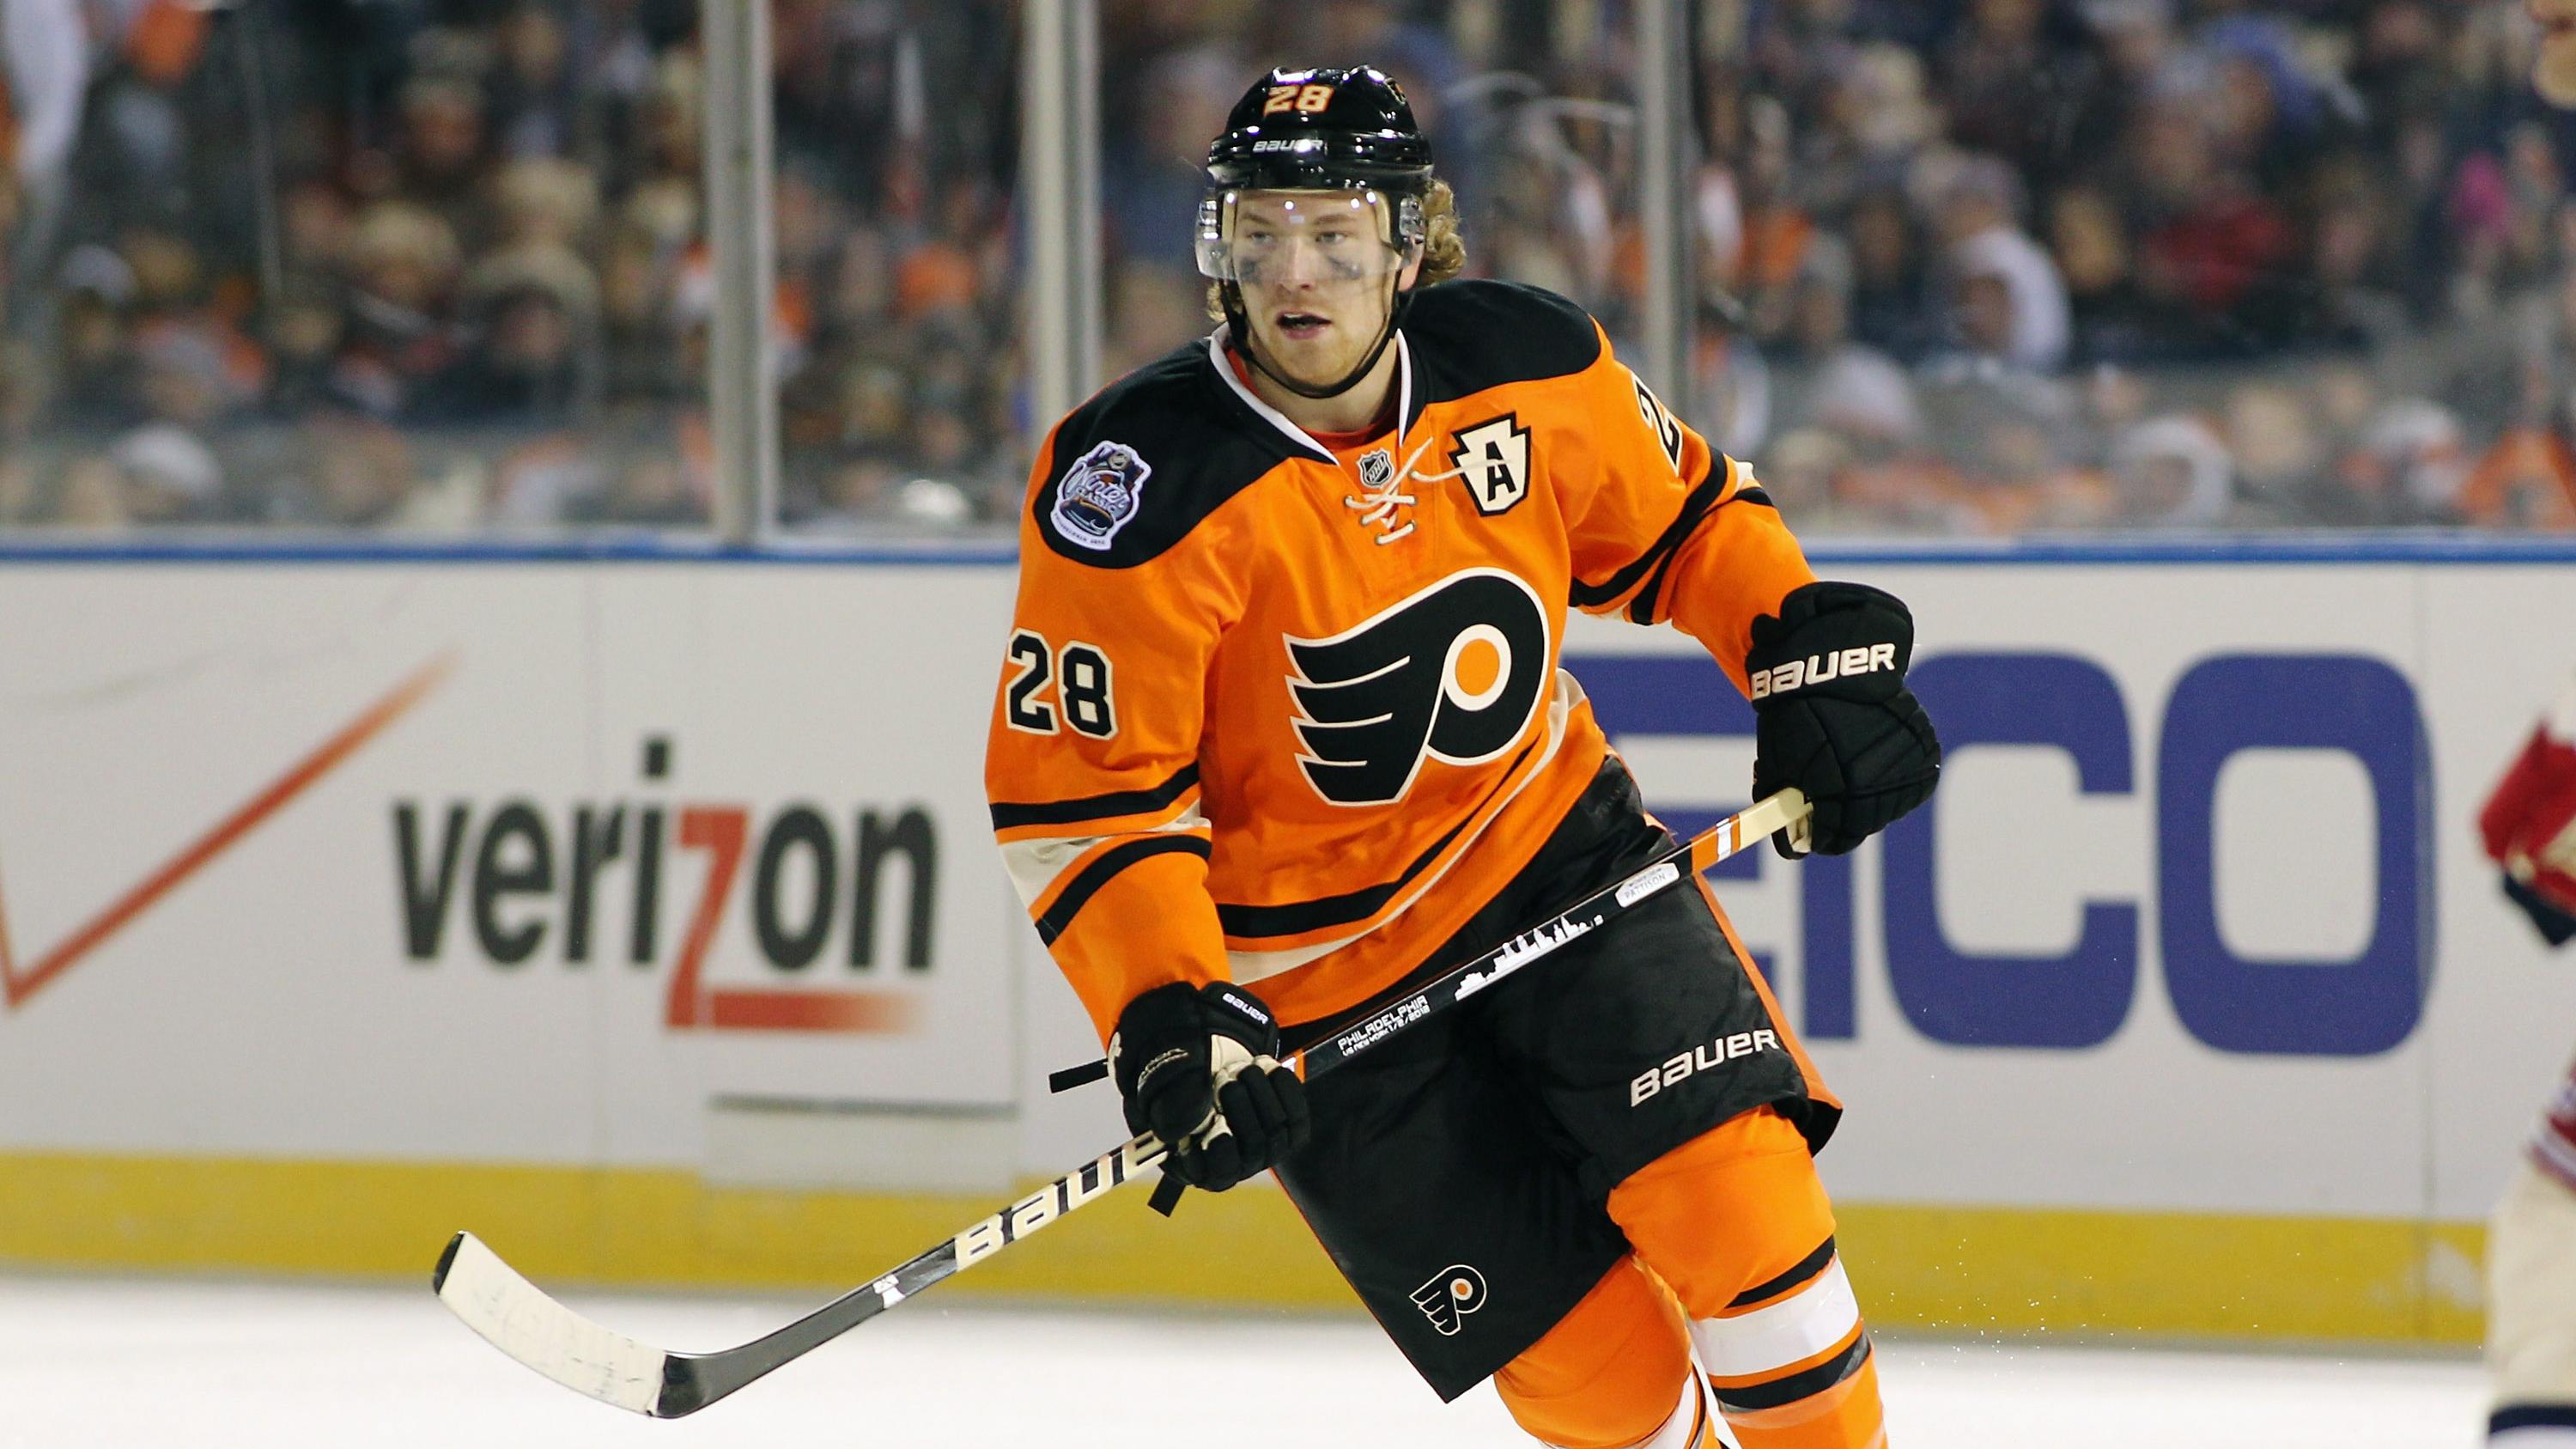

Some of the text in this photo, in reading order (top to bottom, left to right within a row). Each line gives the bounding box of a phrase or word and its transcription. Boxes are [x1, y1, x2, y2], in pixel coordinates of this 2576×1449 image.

[1263, 84, 1334, 117] 28
[1485, 441, 1517, 502] A
[1005, 627, 1119, 741] 28
[392, 736, 938, 1028] verizon
[1624, 873, 1667, 899] PATTISON
[1338, 995, 1428, 1050] PHILADELPHIA
